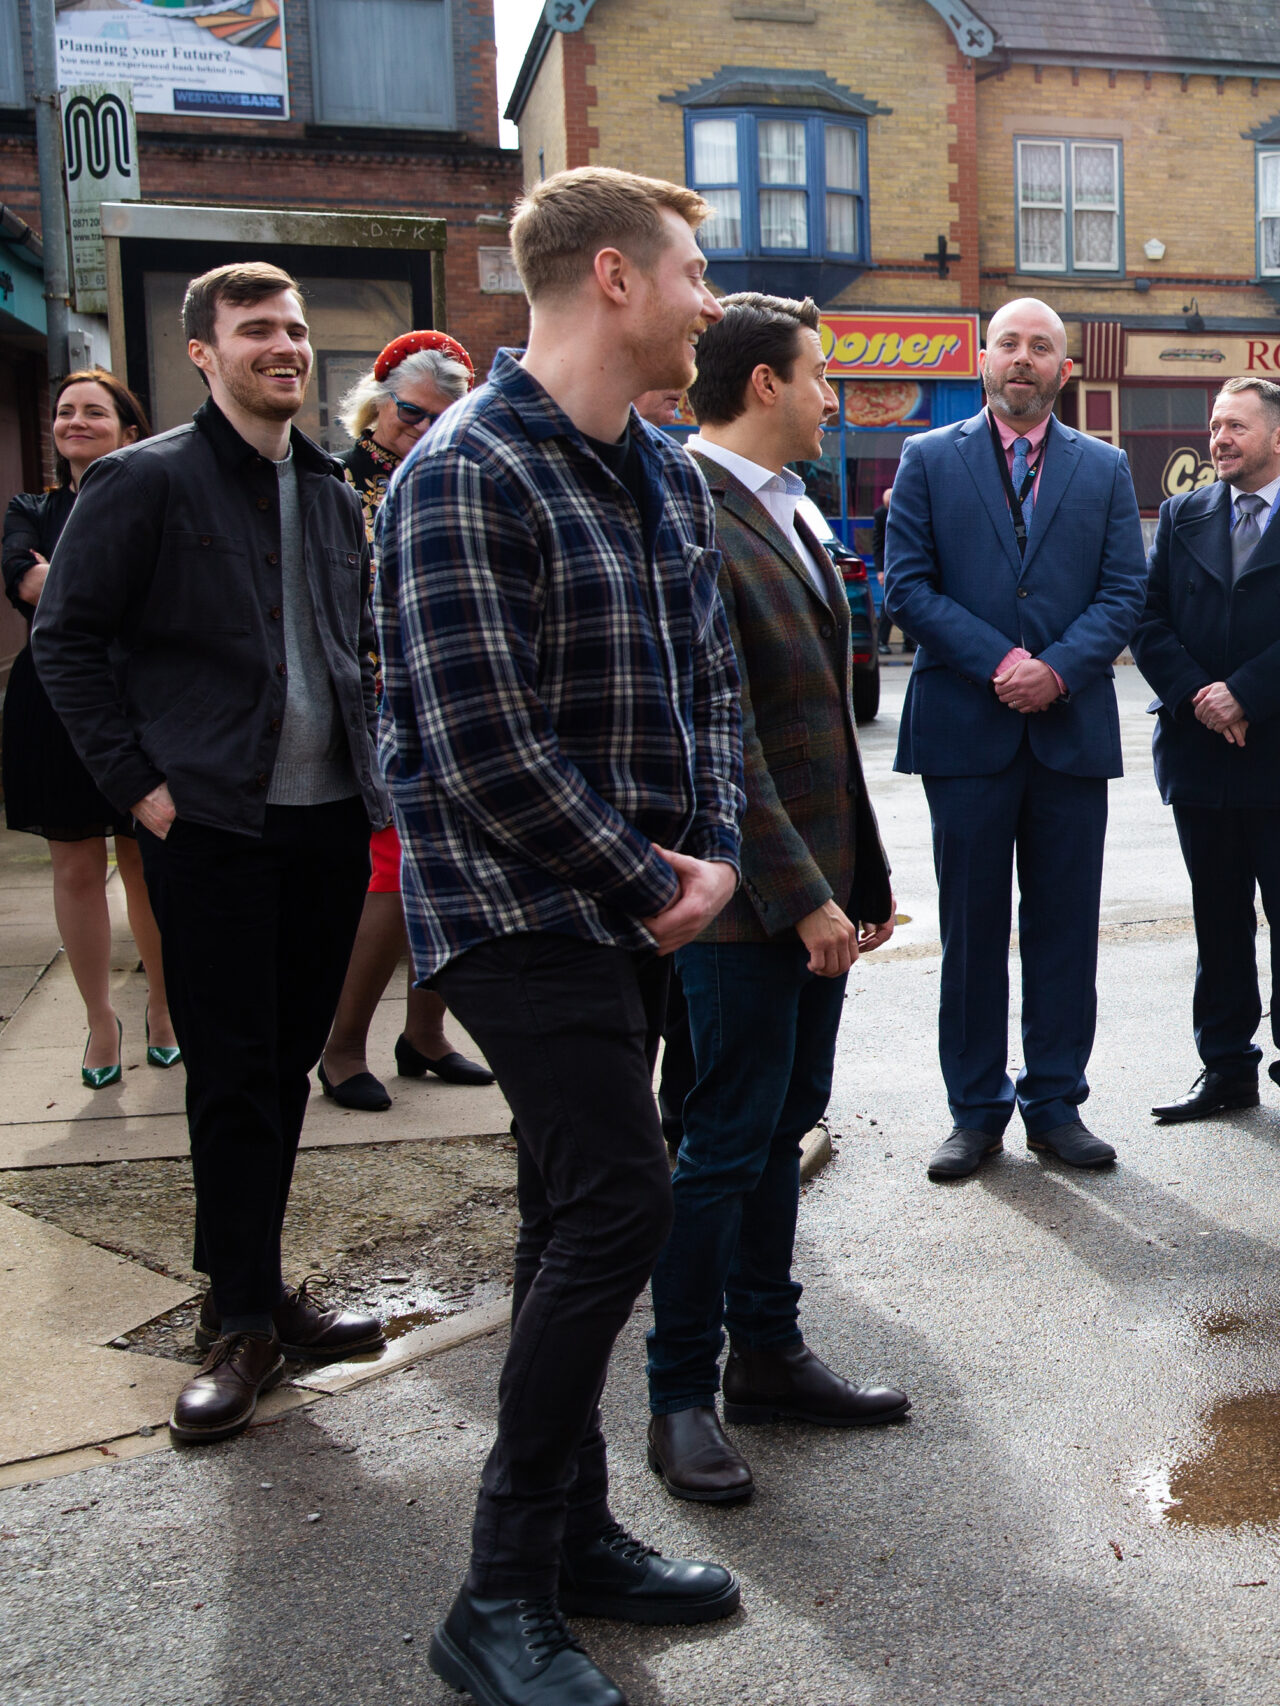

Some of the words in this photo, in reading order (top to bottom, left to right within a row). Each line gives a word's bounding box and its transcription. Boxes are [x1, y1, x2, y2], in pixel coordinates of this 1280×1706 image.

[60, 39, 128, 57] Planning
[132, 46, 168, 59] your
[173, 46, 231, 61] Future?
[61, 56, 77, 64] You
[117, 59, 169, 70] experienced
[172, 63, 194, 71] bank
[196, 65, 227, 73] behind
[72, 219, 89, 228] 0871
